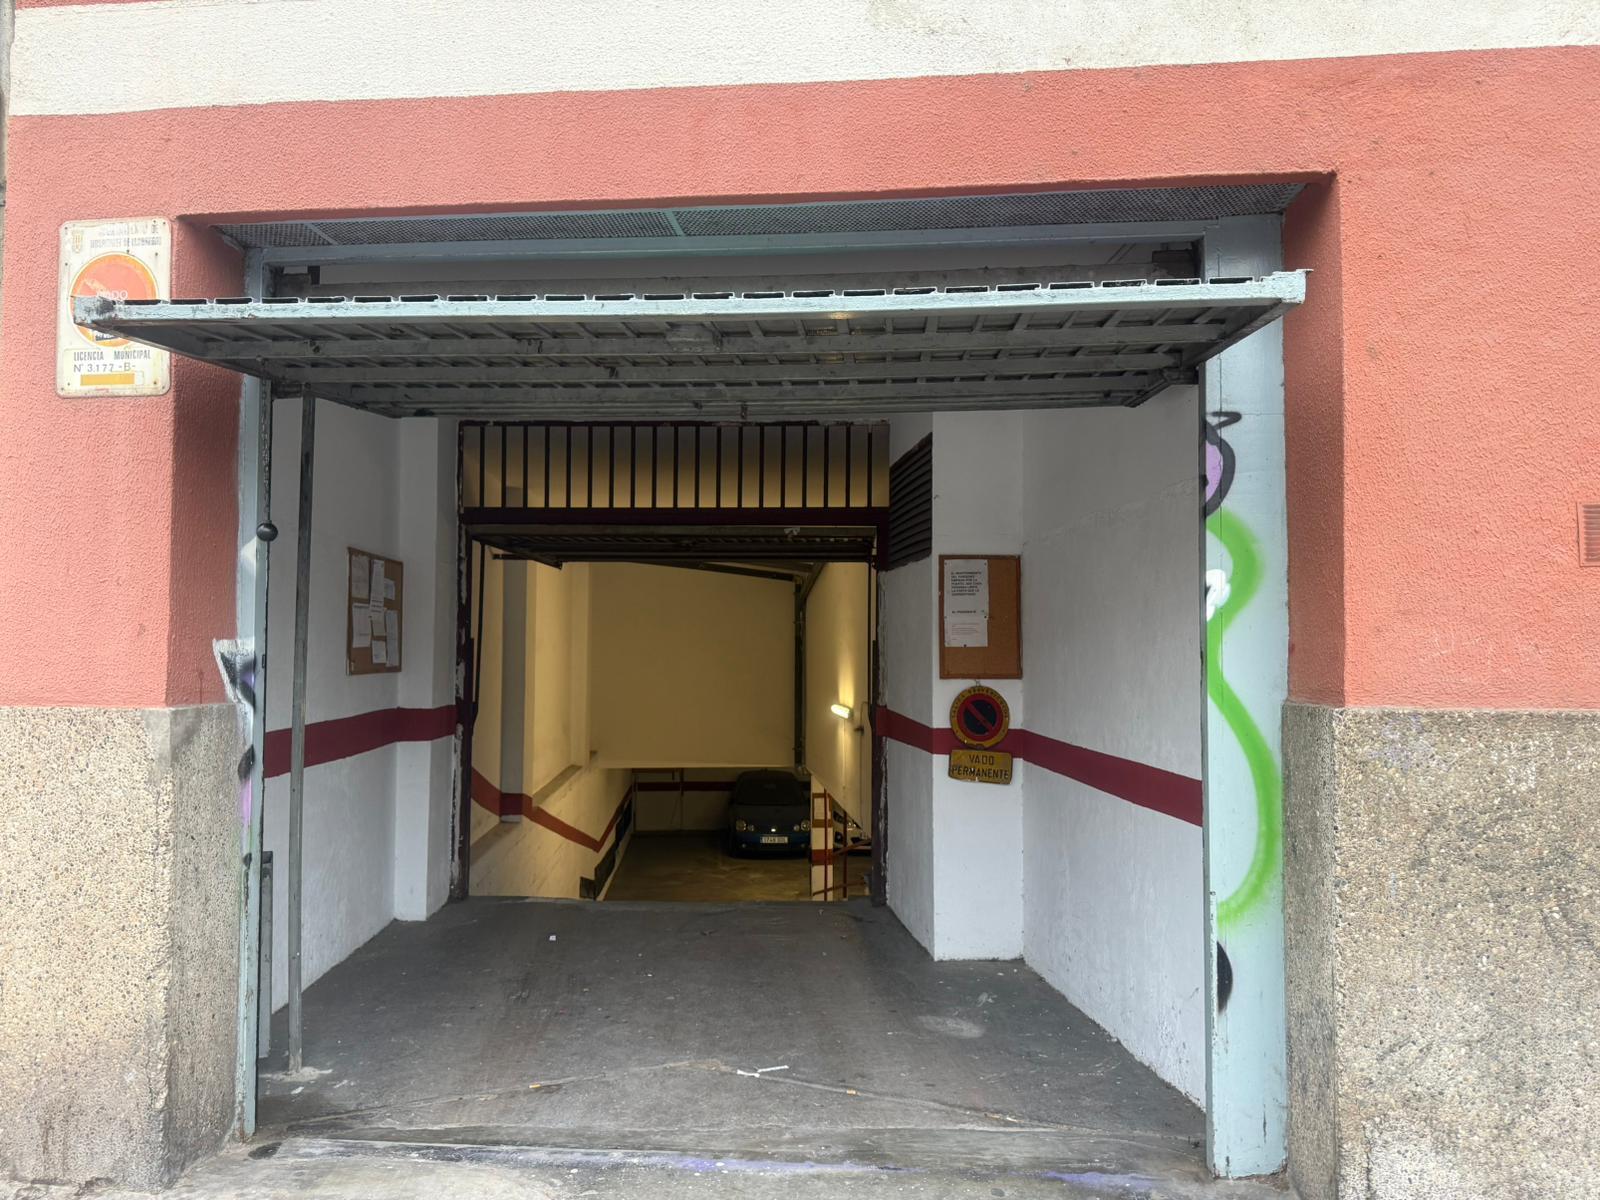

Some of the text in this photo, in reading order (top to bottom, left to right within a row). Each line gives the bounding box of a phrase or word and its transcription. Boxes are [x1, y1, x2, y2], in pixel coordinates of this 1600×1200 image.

[73, 349, 151, 361] LICENCIA MUNICIPAL
[969, 754, 994, 766] VADO
[951, 765, 1009, 779] PERMANENTE
